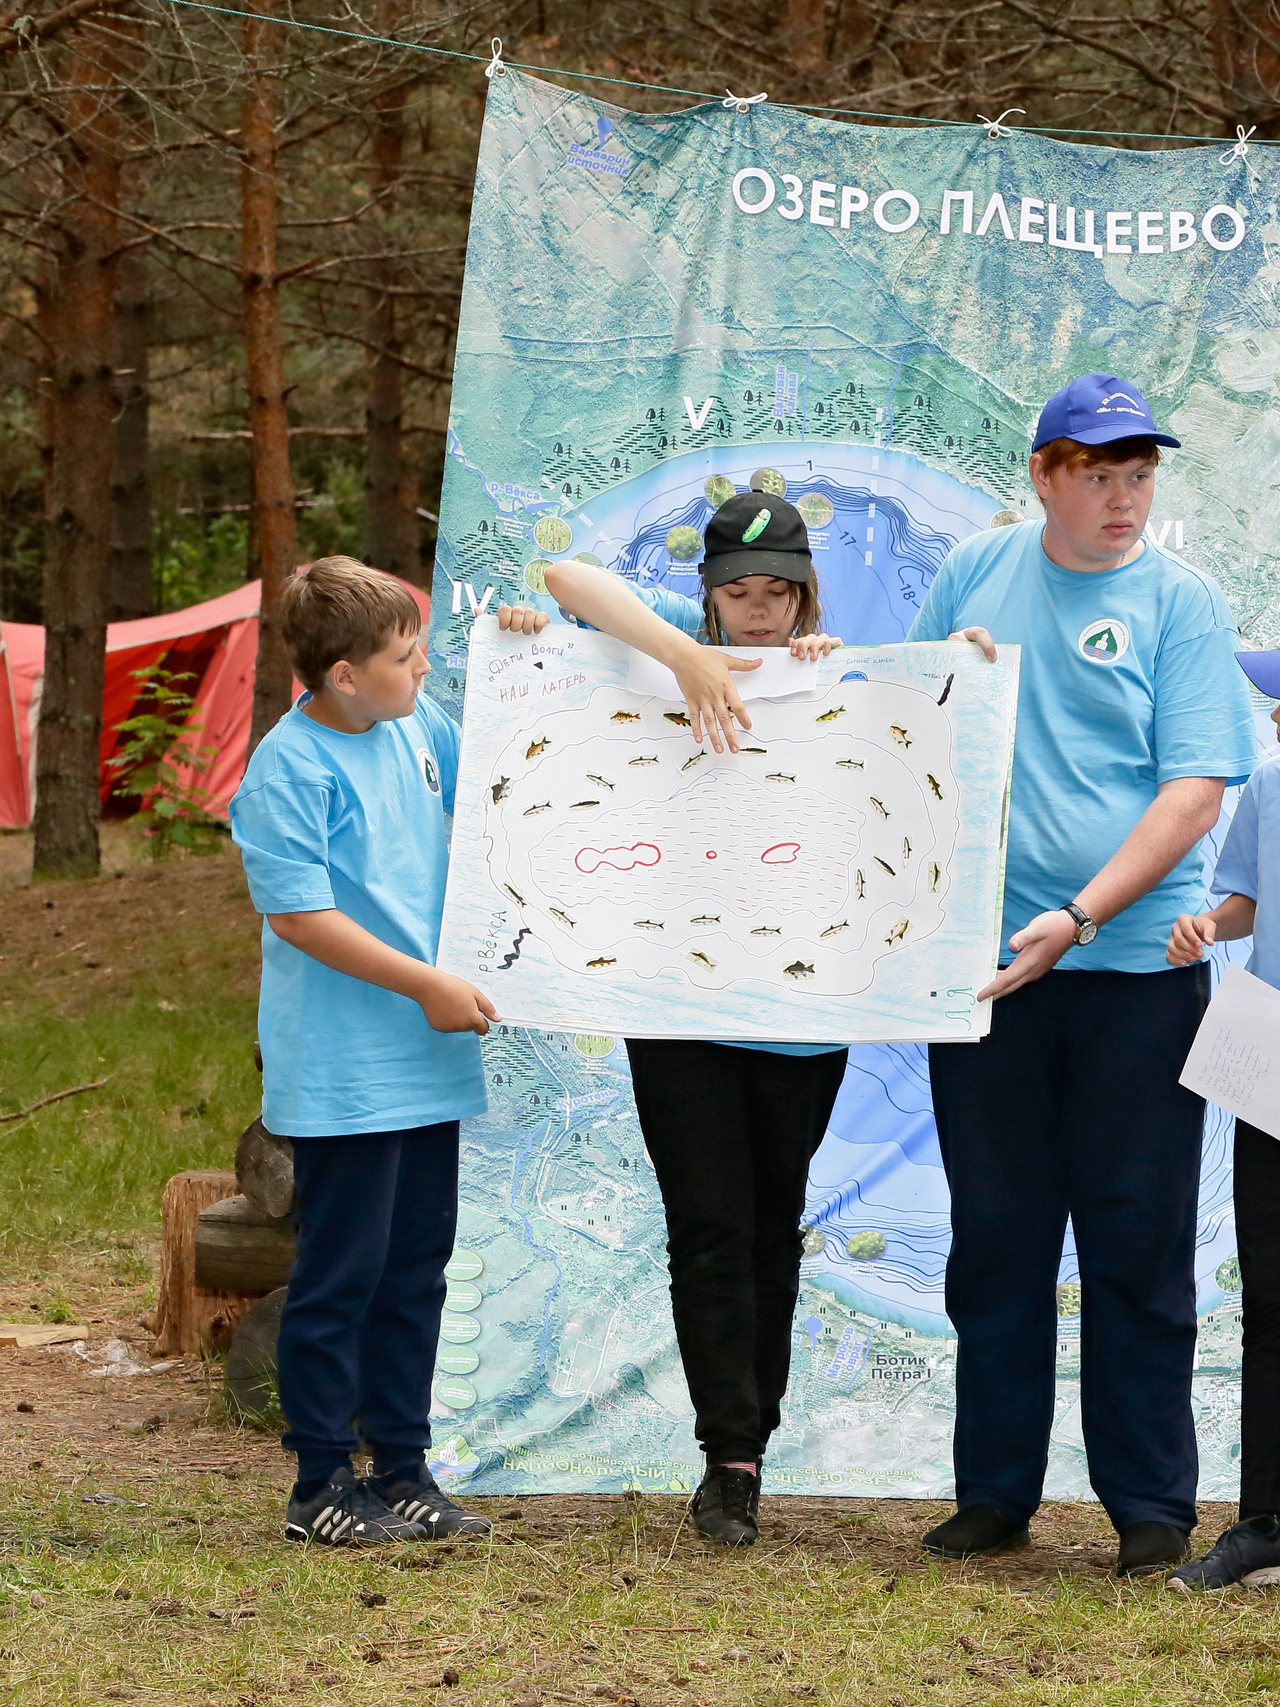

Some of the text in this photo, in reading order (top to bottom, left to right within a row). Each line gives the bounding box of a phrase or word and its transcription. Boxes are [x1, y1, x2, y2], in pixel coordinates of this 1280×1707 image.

[570, 144, 630, 165] Варварин
[568, 156, 629, 175] источник
[732, 167, 1246, 258] ОЗЕРО ПЛЕЩЕЕВО
[773, 365, 785, 417] Валовая
[787, 373, 797, 415] канава
[683, 396, 714, 429] V
[806, 460, 812, 471] 1
[505, 484, 540, 500] Вёкса
[840, 531, 856, 546] 17
[1145, 521, 1184, 549] VI
[452, 581, 495, 615] IV
[900, 584, 916, 600] 18
[500, 672, 587, 703] НАШ ЛАГЕРЬ
[557, 1090, 617, 1109] Куротень
[826, 1326, 853, 1379] Матросов
[845, 1341, 862, 1372] овраг
[876, 1354, 926, 1366] Ботик
[871, 1368, 931, 1381] Петра I
[659, 1459, 704, 1474] ресурс
